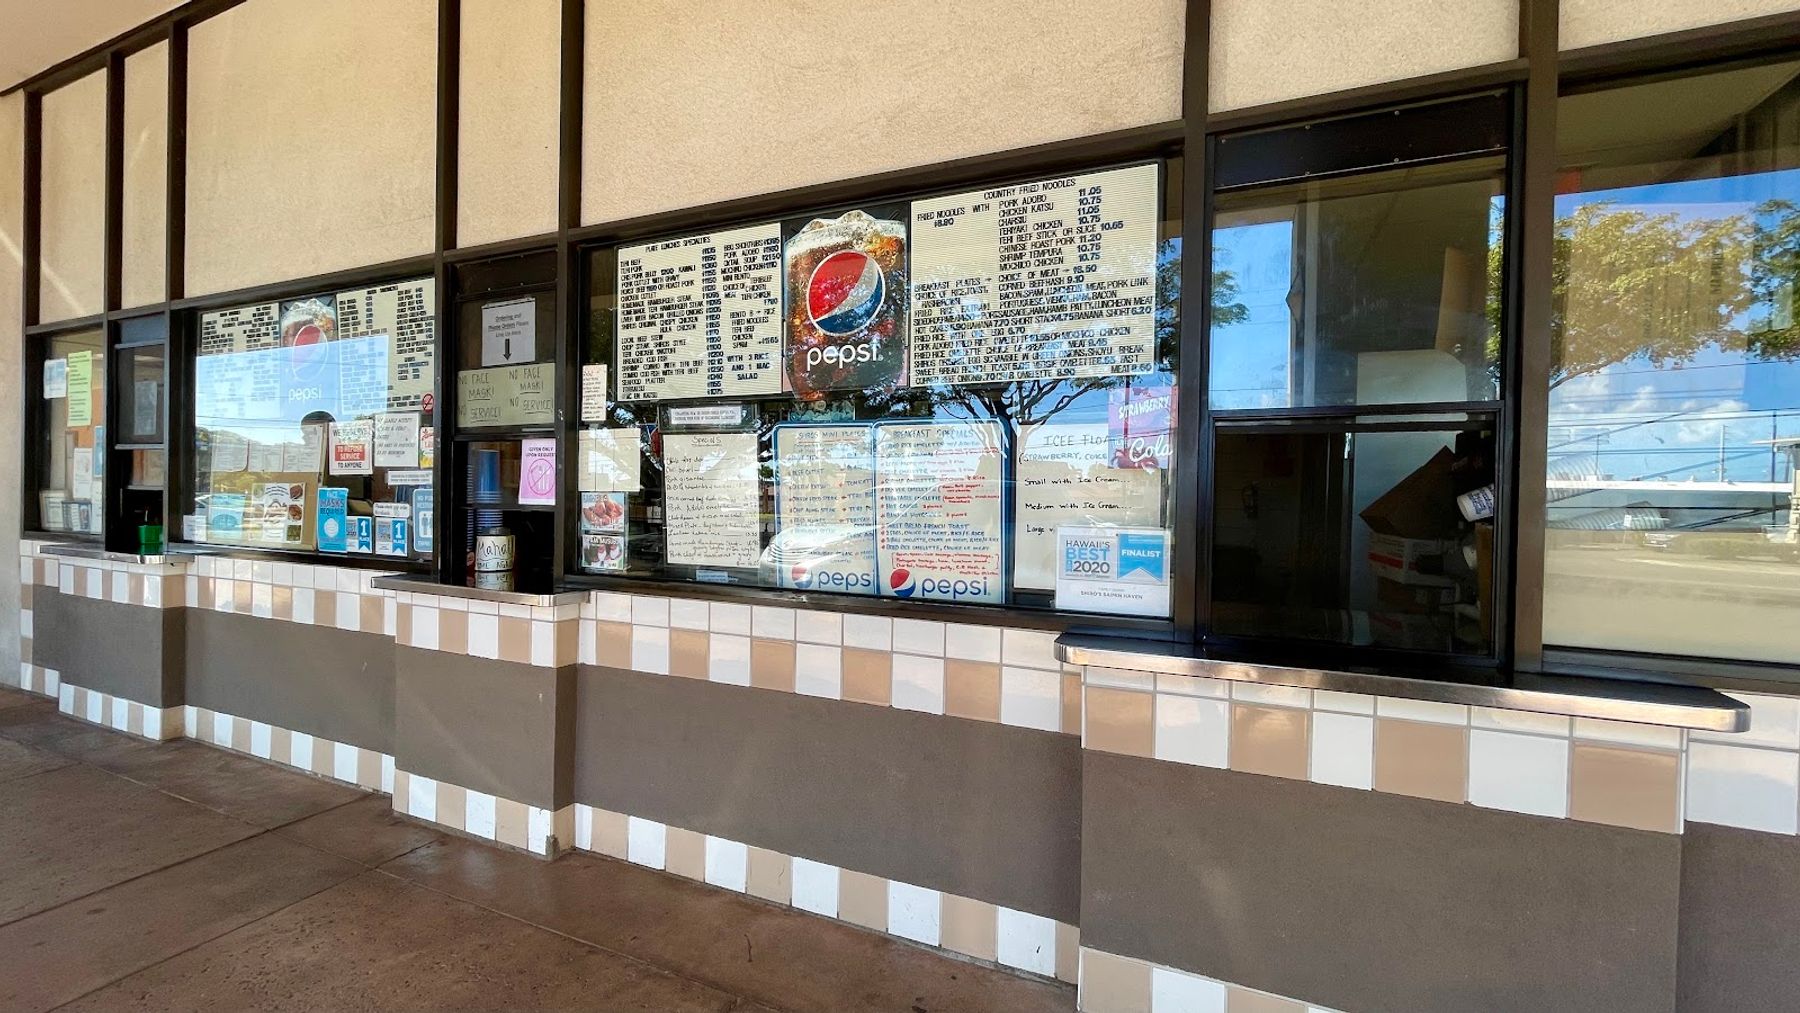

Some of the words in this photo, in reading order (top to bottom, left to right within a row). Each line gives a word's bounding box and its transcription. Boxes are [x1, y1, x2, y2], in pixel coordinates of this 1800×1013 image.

[984, 187, 1015, 199] COUNTRY
[1019, 183, 1038, 194] FRIED
[1042, 178, 1075, 191] NOODLES
[998, 198, 1018, 208] PORK
[1022, 193, 1046, 205] ADOBO
[998, 206, 1027, 217] CHICKEN
[1031, 202, 1053, 213] KATSU
[1078, 195, 1101, 206] 10.75
[936, 206, 964, 218] NOODLES
[972, 202, 989, 213] WITH
[1077, 205, 1099, 216] 11.05
[999, 224, 1027, 235] TERIYAKI
[1032, 219, 1062, 231] CHICKEN
[1078, 214, 1100, 225] 10.75
[999, 235, 1012, 244] TERI
[1016, 232, 1032, 242] BEEF
[1036, 229, 1055, 239] STICK
[1062, 227, 1072, 236] OR
[1076, 224, 1096, 234] SLICE
[999, 242, 1027, 253] CHINESE
[1031, 238, 1053, 249] ROAST
[1055, 236, 1075, 246] PORK
[1078, 232, 1101, 243] 11.20
[999, 251, 1025, 262] SHRIMP
[1029, 247, 1062, 258] TEMPURA
[1077, 242, 1100, 253] 10.75
[1033, 256, 1063, 267] CHICKEN
[1078, 252, 1100, 262] 10.75
[998, 272, 1021, 282] CHOICE
[1027, 271, 1035, 279] OF
[1040, 268, 1059, 277] MEAT
[1067, 274, 1084, 284] 9.10
[1130, 276, 1148, 286] LINK
[806, 338, 878, 371] pepsi
[523, 367, 540, 378] FACE
[737, 372, 757, 380] SALAD
[288, 385, 322, 404] pepsi
[1118, 396, 1170, 419] STRAWBERRY
[1043, 435, 1076, 447] ICEE
[1083, 433, 1112, 446] FLOA
[1129, 436, 1173, 463] Cola
[319, 498, 344, 507] MASKS
[1082, 501, 1095, 509] Ice
[319, 507, 344, 515] REQUIRED
[360, 519, 367, 536] 1
[395, 521, 402, 538] 1
[1066, 548, 1110, 561] BEST
[1121, 549, 1161, 558] FINALIST
[1072, 560, 1110, 574] 2020
[818, 571, 875, 591] peps
[921, 577, 988, 599] pepsi
